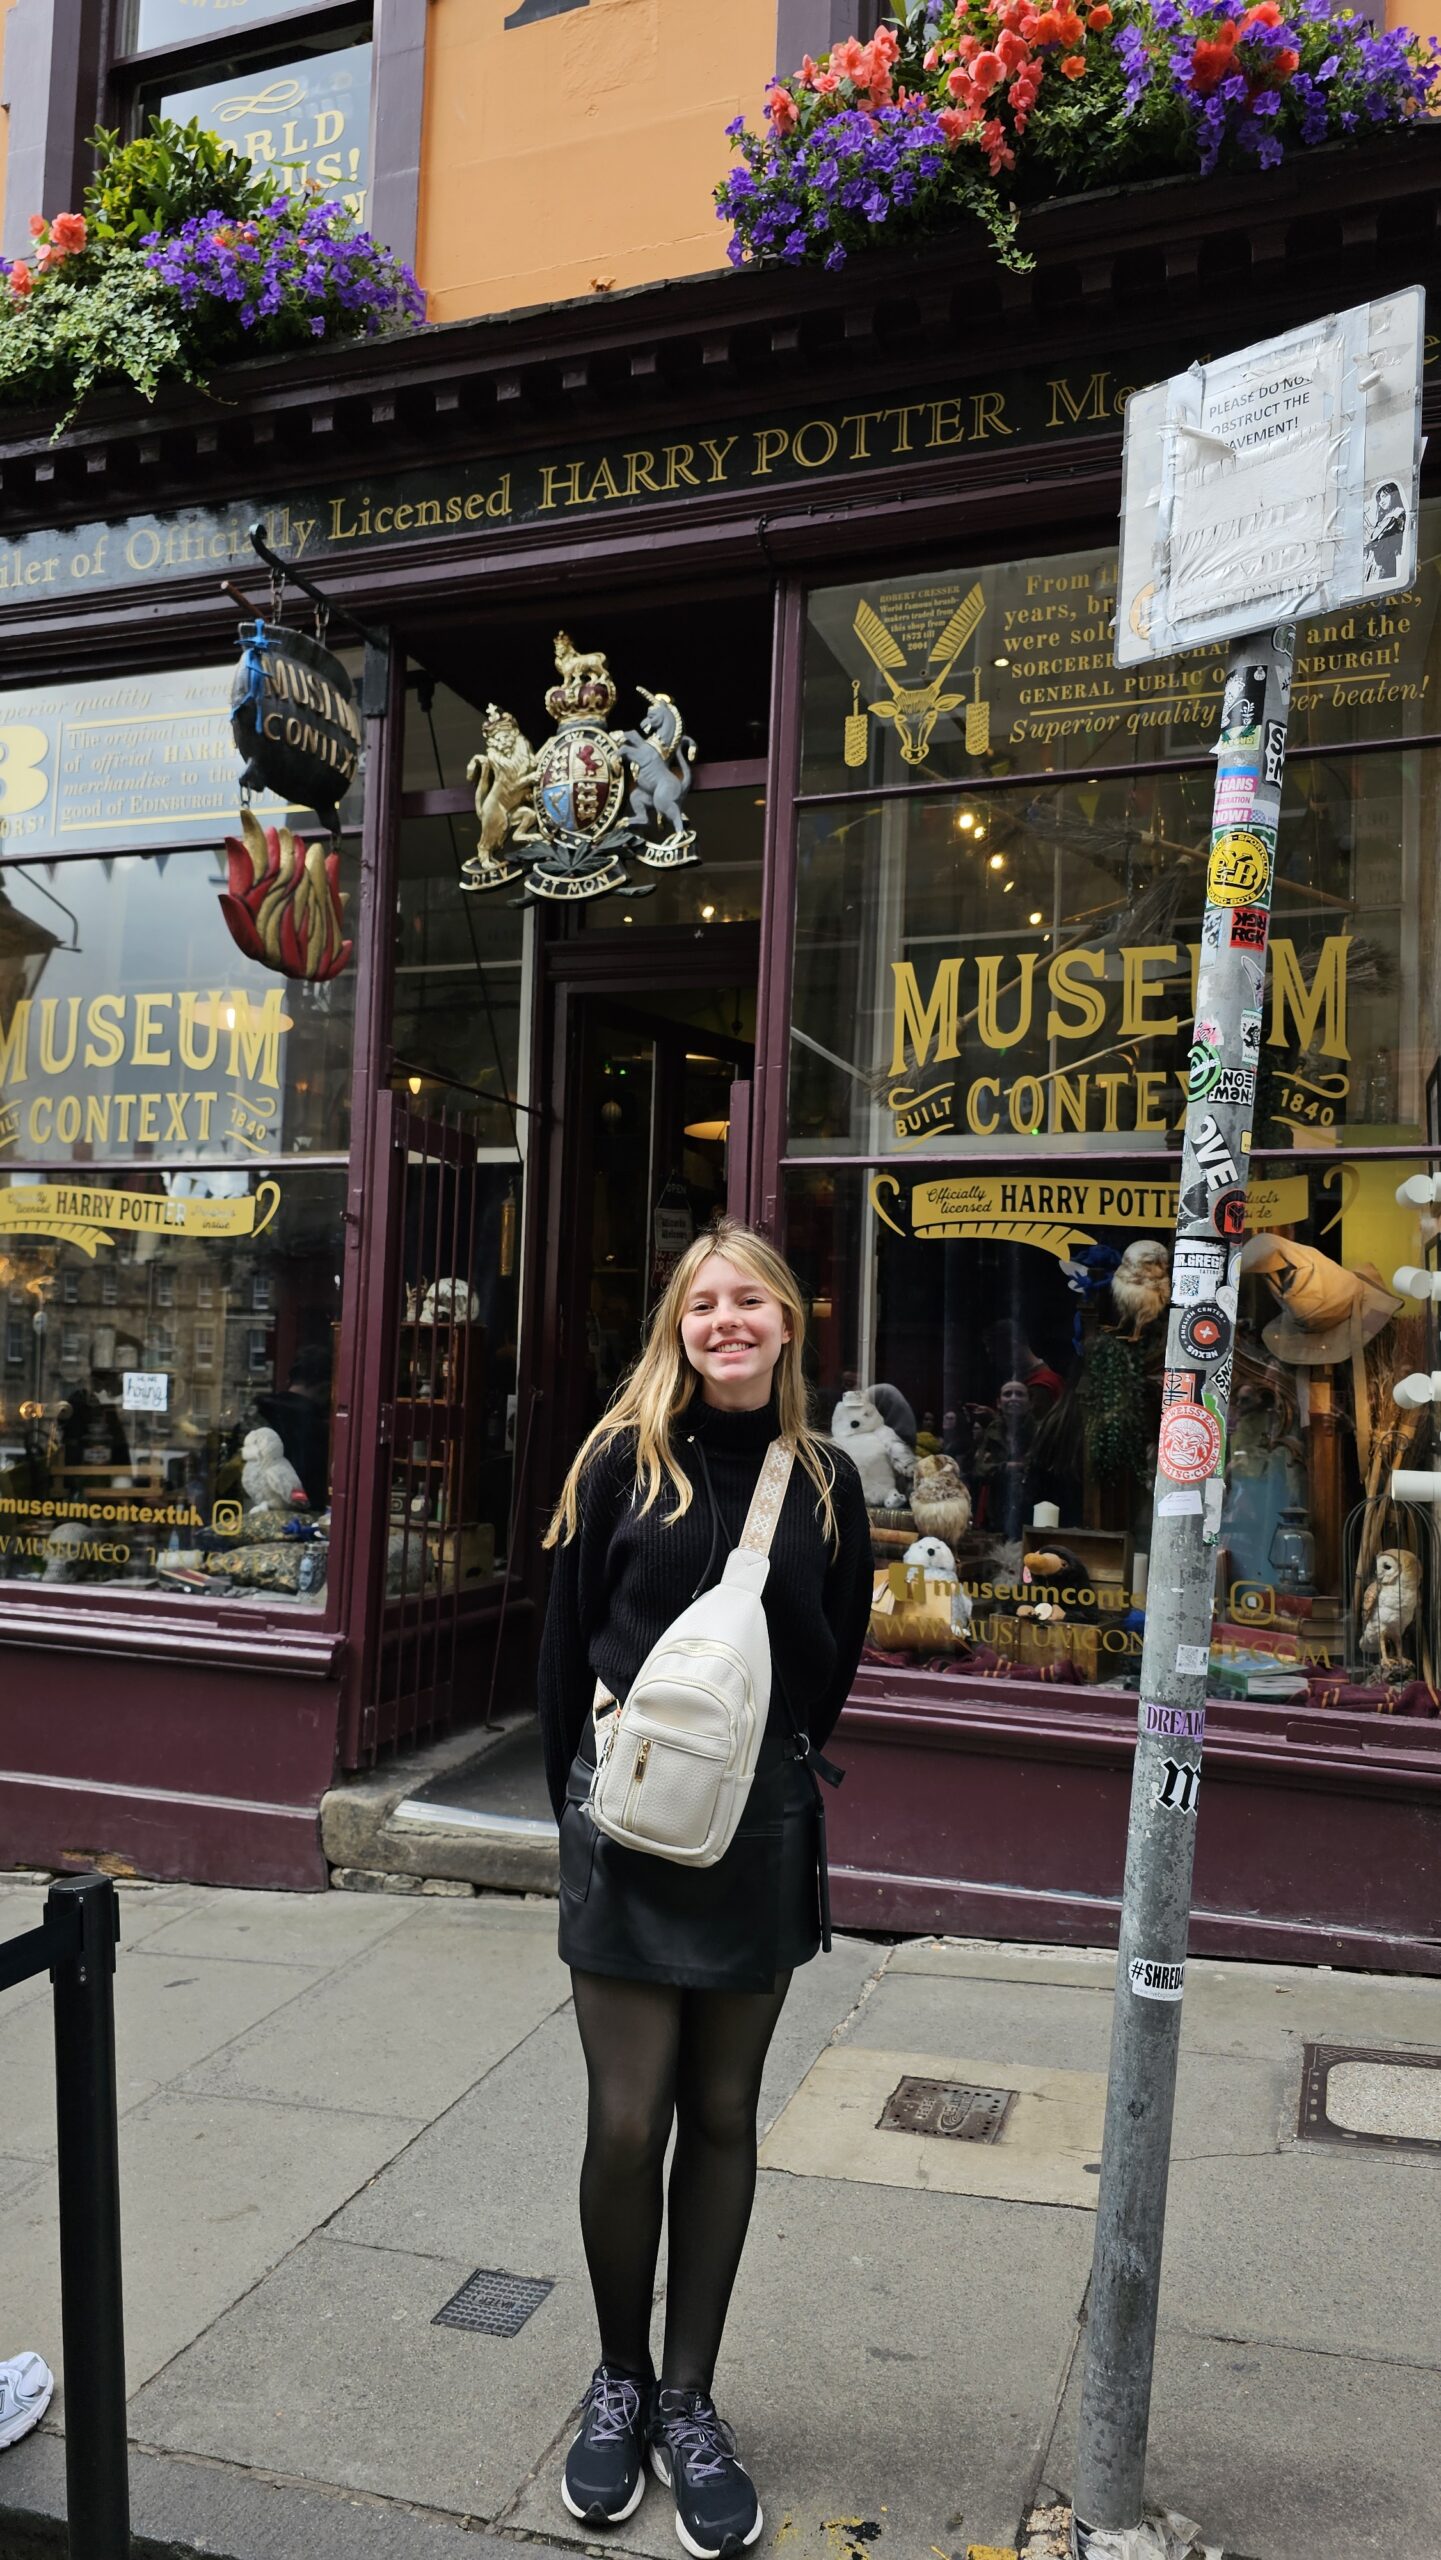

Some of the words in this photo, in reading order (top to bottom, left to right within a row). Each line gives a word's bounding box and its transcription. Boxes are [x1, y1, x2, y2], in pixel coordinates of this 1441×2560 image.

[1208, 387, 1255, 418] PLEASE
[1258, 378, 1279, 399] DO
[1282, 373, 1312, 393] NO
[1210, 401, 1279, 435] OBSTRUCT
[1283, 391, 1311, 412] THE
[69, 535, 109, 579] of
[327, 473, 511, 541] Licensed
[538, 436, 737, 510] HARRY
[751, 391, 1011, 477] POTTER
[880, 591, 916, 603] ROBERT
[1026, 571, 1091, 597] From
[891, 623, 906, 633] this
[907, 621, 926, 632] shop
[928, 620, 946, 629] from
[936, 608, 953, 617] from
[1004, 602, 1077, 632] years,
[1003, 631, 1061, 653] were
[1306, 618, 1354, 645] and
[1366, 613, 1411, 639] the
[1296, 641, 1402, 675] NBURGH!
[1019, 680, 1115, 705] GENERAL
[1125, 669, 1203, 694] PUBLIC
[0, 700, 67, 722] perior
[75, 687, 153, 715] quality
[1009, 710, 1120, 745] Superior
[1127, 700, 1217, 736] quality
[1331, 675, 1430, 708] beaten!
[68, 731, 104, 751] The
[106, 725, 176, 749] original
[179, 718, 211, 739] and
[64, 754, 85, 775] of
[91, 751, 155, 775] official
[63, 775, 171, 798] merchandise
[181, 770, 199, 787] to
[208, 765, 237, 785] the
[1216, 777, 1254, 793] TRANS
[62, 799, 102, 823] good
[106, 797, 125, 815] of
[130, 793, 225, 815] EDINBURGH
[540, 878, 558, 895] ET
[566, 874, 610, 895] MON
[1231, 927, 1265, 946] RGK
[888, 936, 1352, 1077] MUSEM
[28, 1091, 218, 1144] CONTEXT
[230, 1107, 267, 1141] 1840
[895, 1094, 954, 1138] BUILT
[1279, 1087, 1336, 1128] 1840
[56, 1191, 114, 1219] HARRY
[120, 1198, 186, 1228] POTTER
[926, 1184, 988, 1204] Officially
[1000, 1184, 1091, 1216] HARRY
[1098, 1185, 1179, 1219] POTTE
[941, 1198, 993, 1216] licensed
[1196, 1306, 1224, 1319] CENTER
[1185, 1345, 1219, 1359] NEXUS
[1170, 1405, 1201, 1417] WEISS
[1201, 1413, 1220, 1447] ESSEN
[1194, 1451, 1220, 1478] CREW
[1147, 1706, 1205, 1736] DREAM
